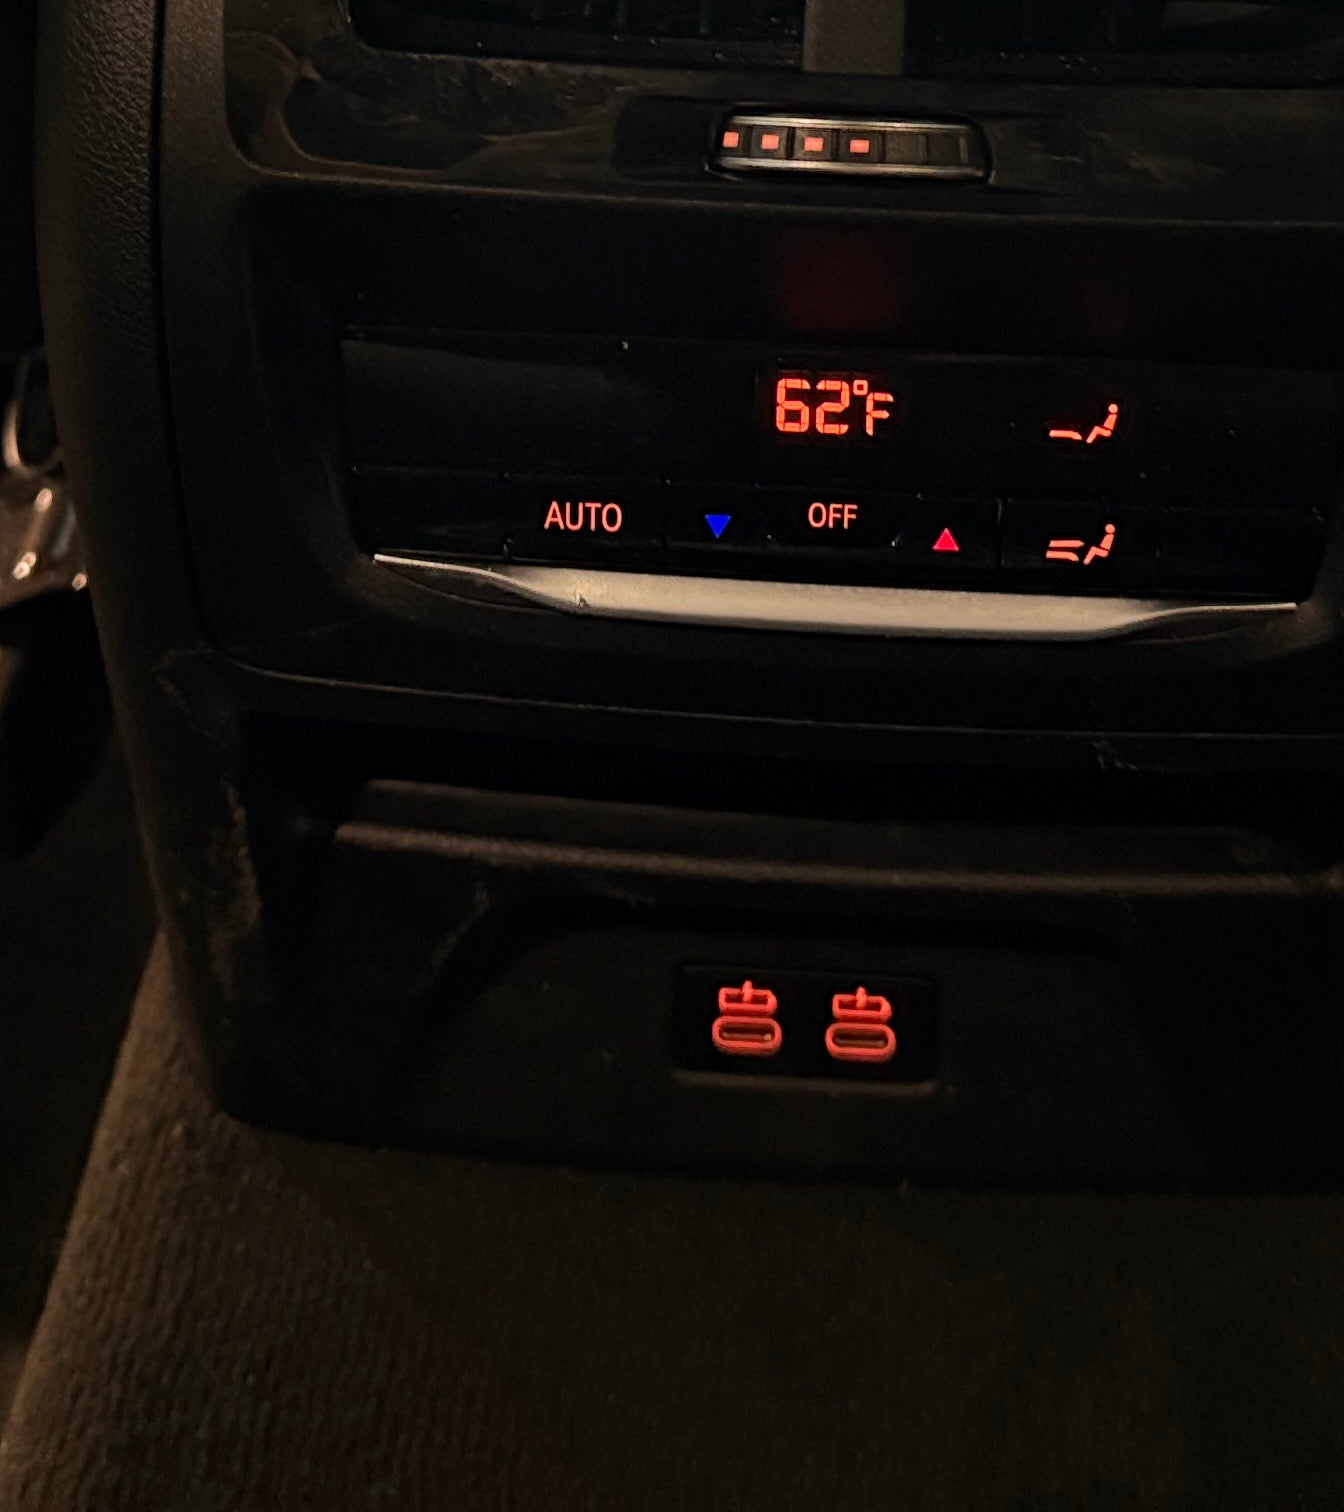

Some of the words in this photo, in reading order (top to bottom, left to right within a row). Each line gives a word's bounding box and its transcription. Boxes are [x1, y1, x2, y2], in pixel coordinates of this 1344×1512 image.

[775, 378, 895, 437] 62°F
[543, 500, 623, 533] AUTO
[807, 501, 859, 530] OFF
